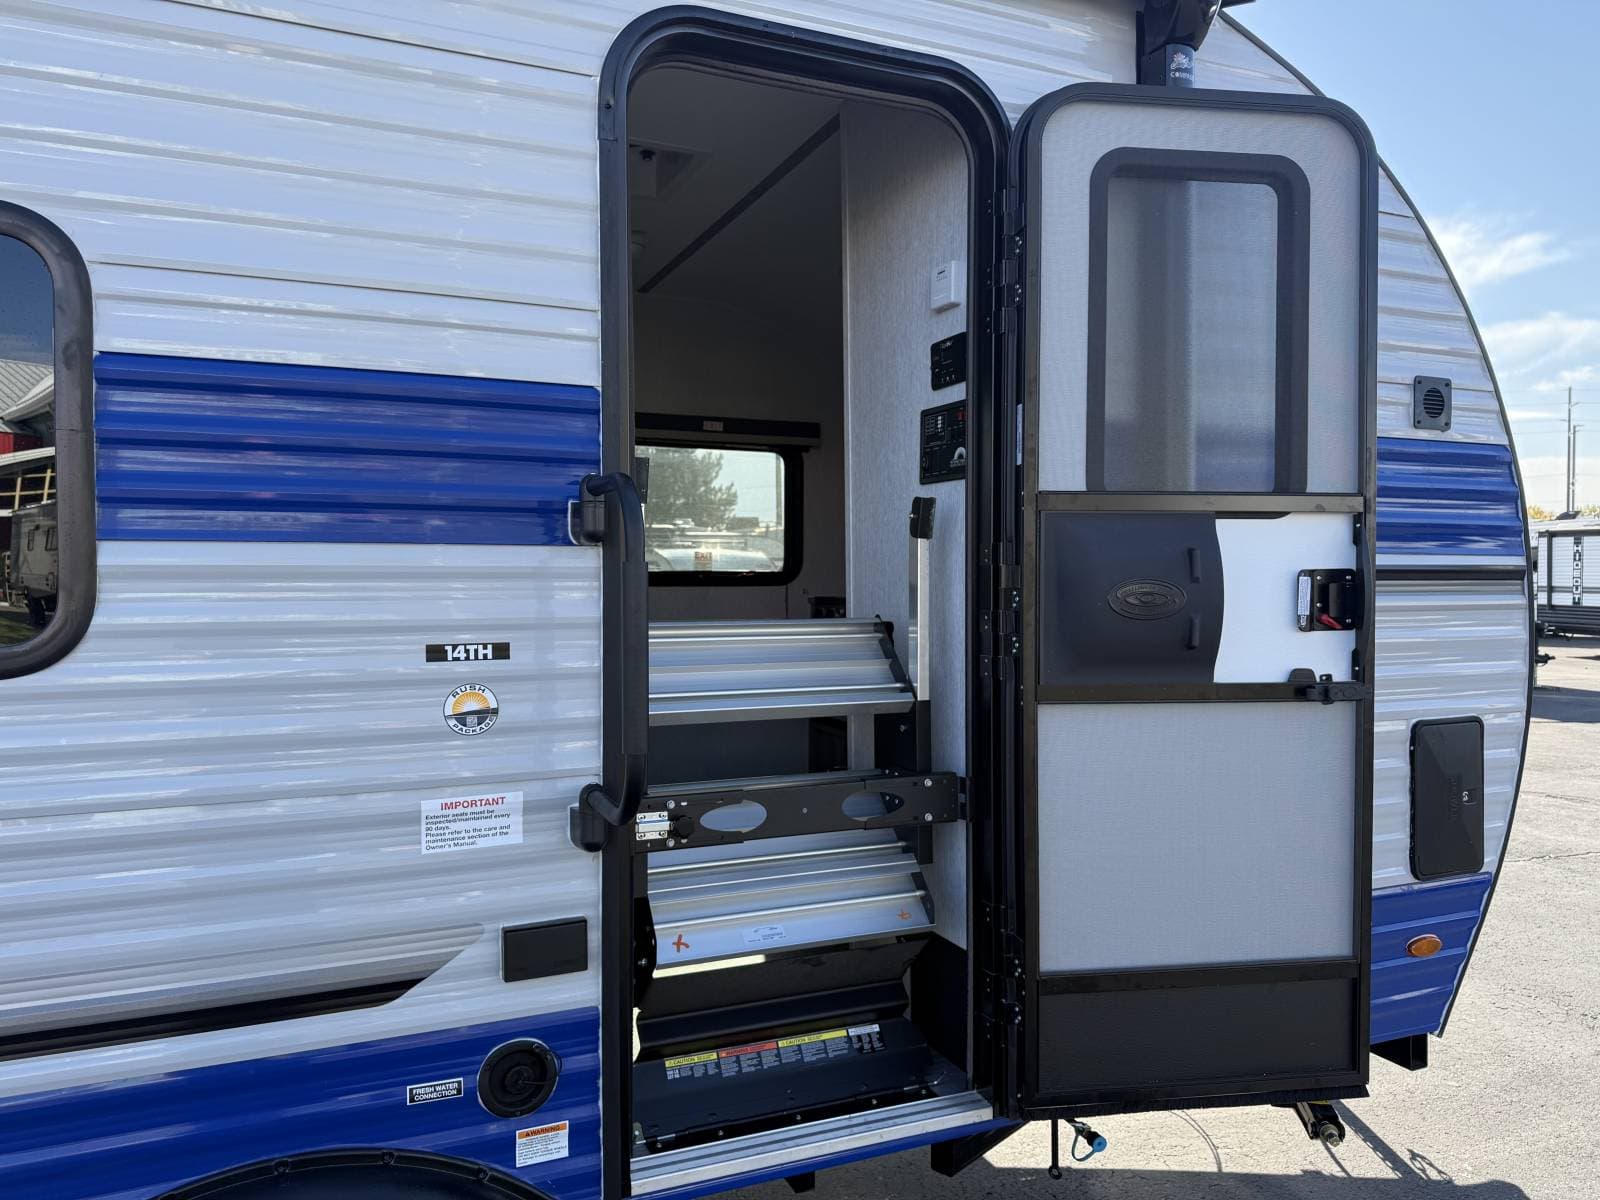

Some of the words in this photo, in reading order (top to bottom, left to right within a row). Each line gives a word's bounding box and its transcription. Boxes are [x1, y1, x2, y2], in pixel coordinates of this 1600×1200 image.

[1573, 544, 1581, 603] HIDEOUT
[444, 644, 493, 661] 14TH
[451, 685, 486, 698] RUSH
[452, 716, 495, 733] PACKAGE
[441, 797, 506, 810] IMPORTANT
[425, 816, 492, 826] inspected/maintained
[425, 836, 465, 844] maintenance
[412, 1086, 434, 1095] FRESH
[435, 1083, 459, 1091] WATER
[414, 1089, 457, 1101] CONNECTION
[531, 1125, 560, 1136] WARNING
